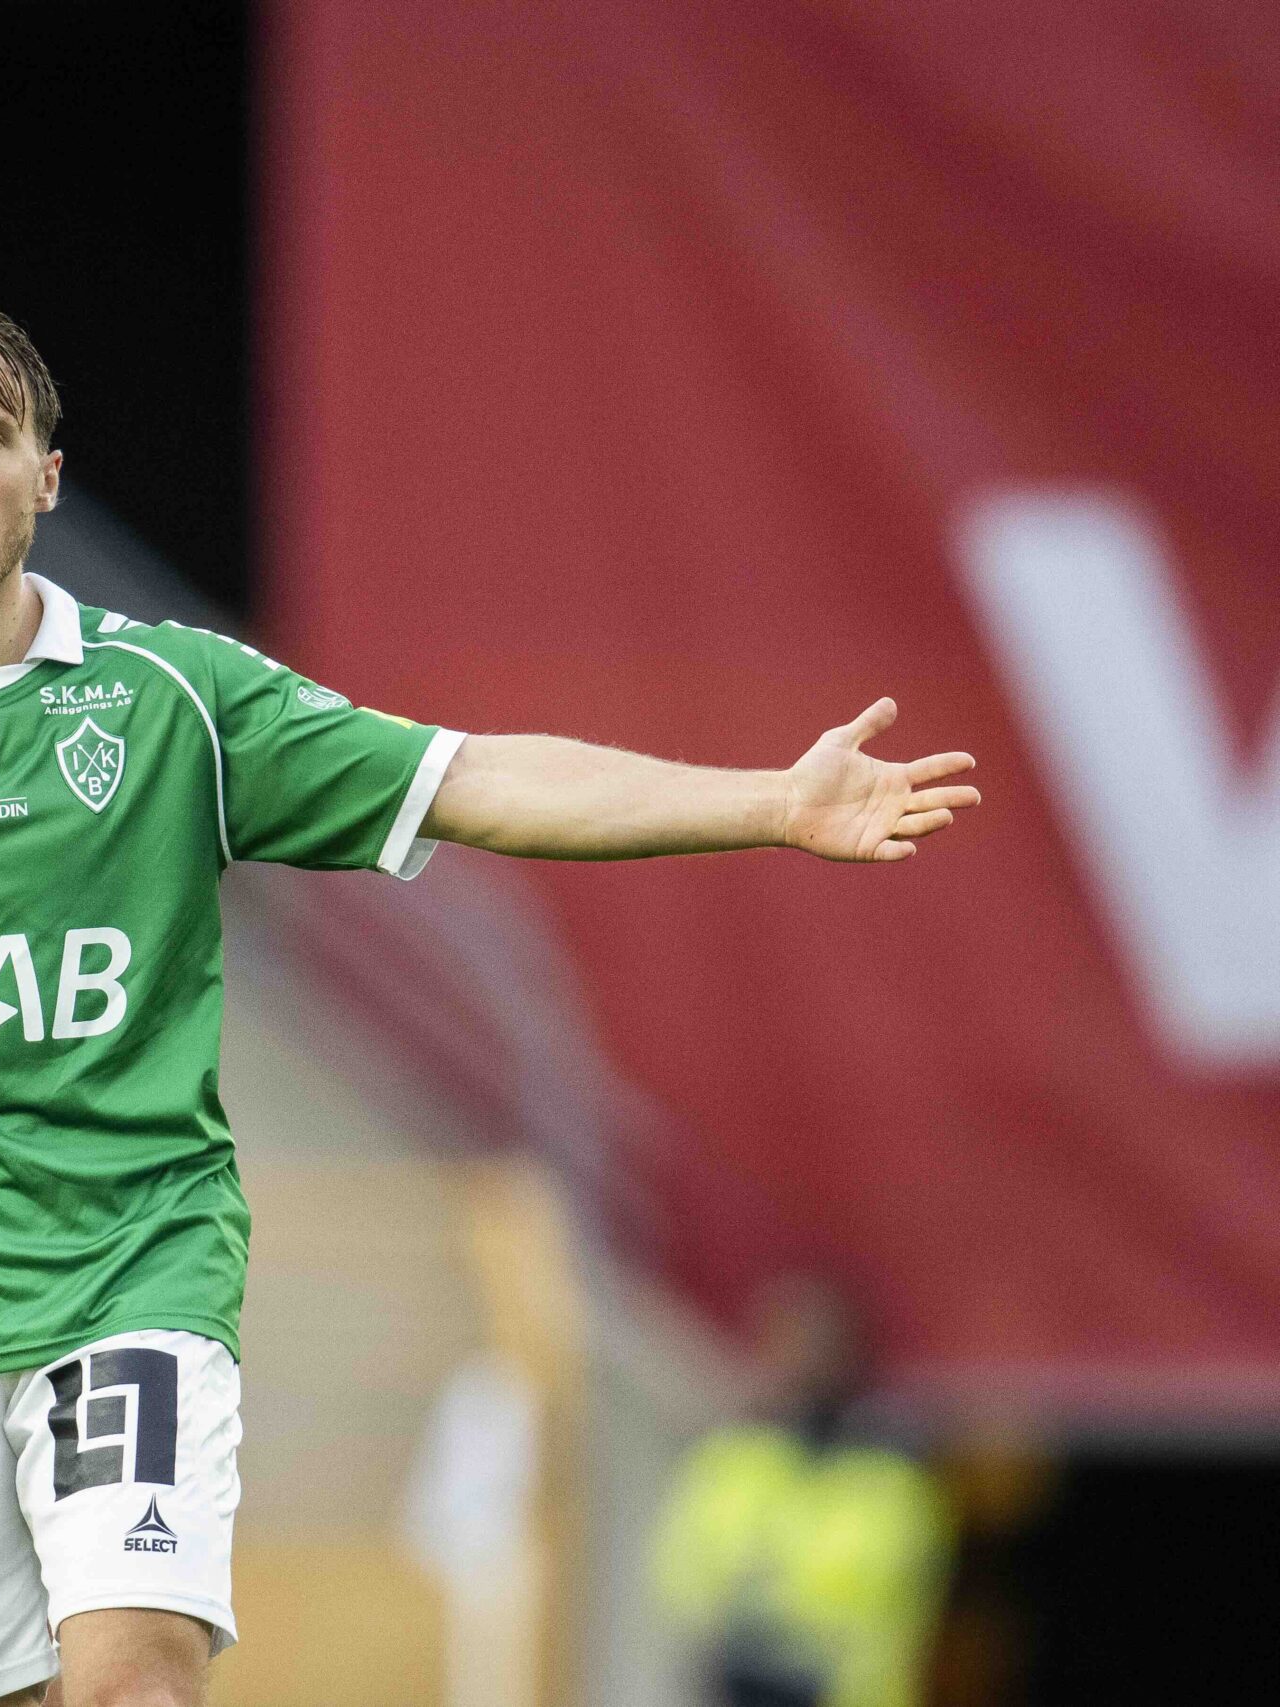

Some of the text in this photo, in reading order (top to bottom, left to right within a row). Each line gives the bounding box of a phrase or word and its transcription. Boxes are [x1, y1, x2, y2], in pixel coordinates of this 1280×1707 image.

[40, 681, 134, 704] S.K.M.A.
[44, 697, 132, 715] Anläggnings AB
[124, 1537, 178, 1554] SELECT
